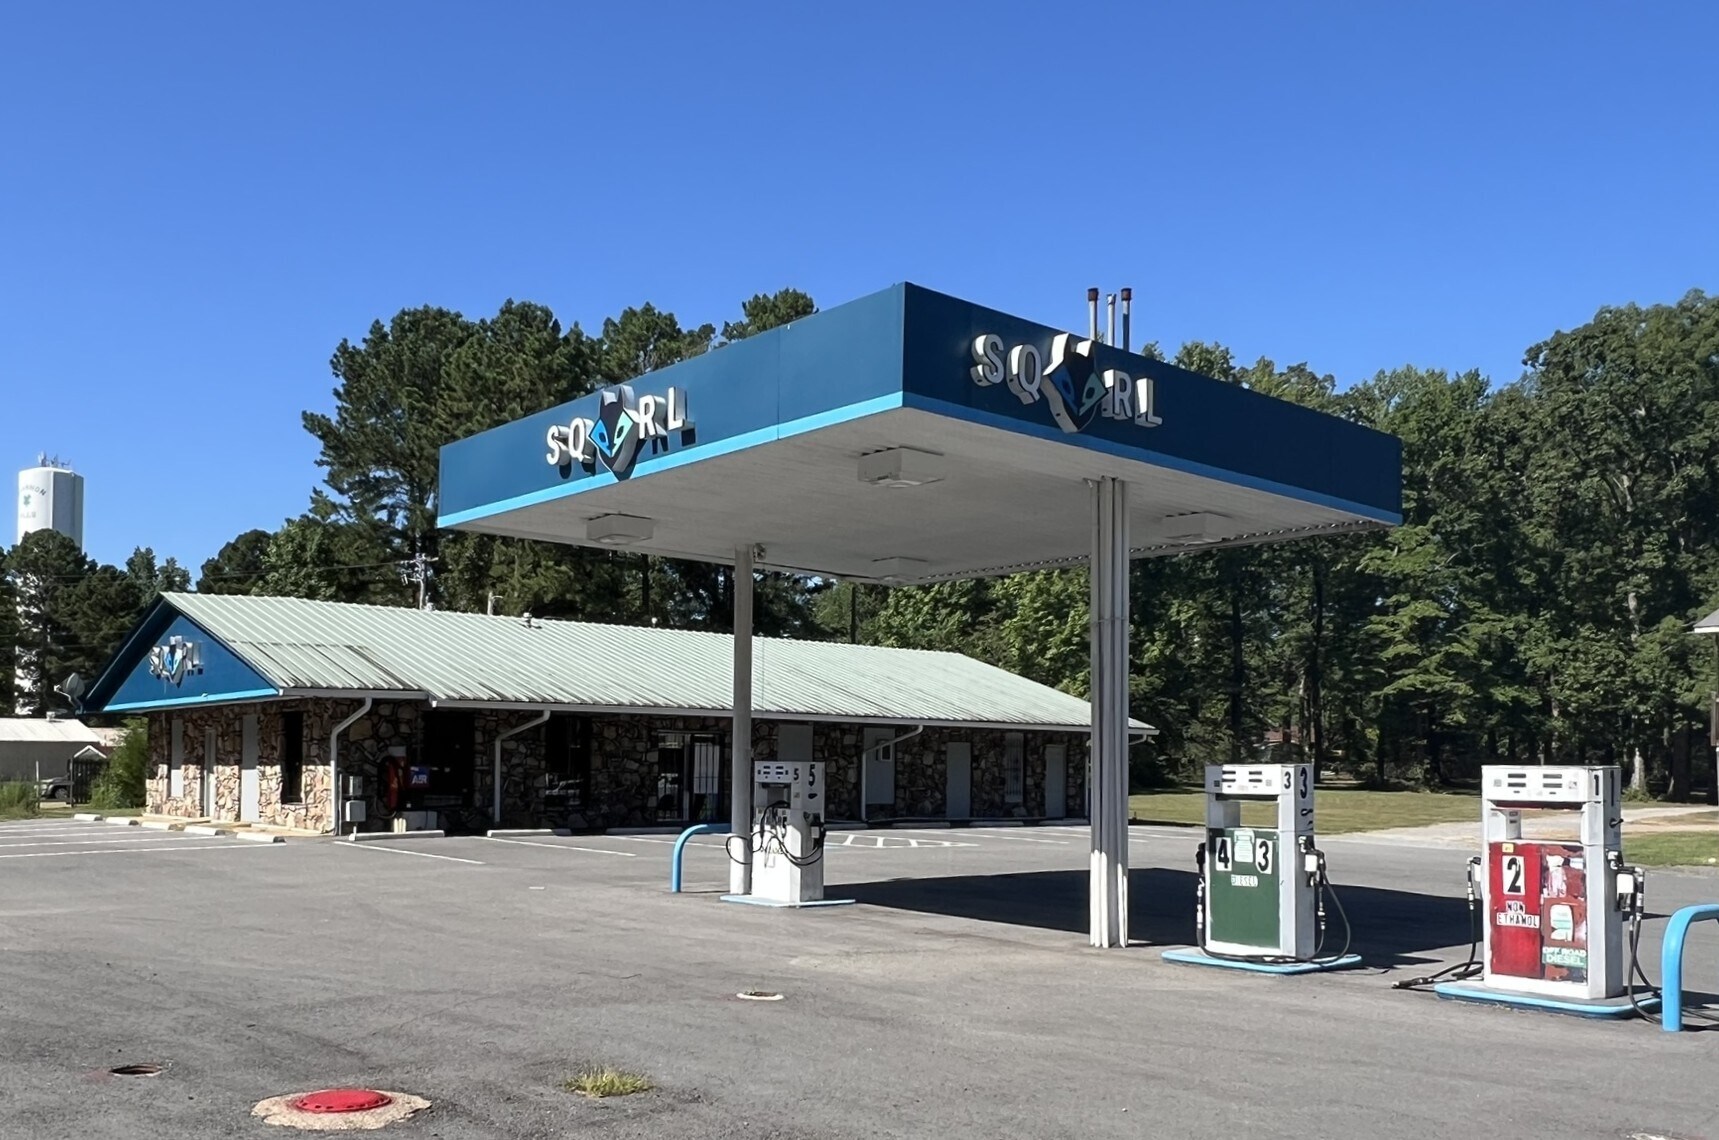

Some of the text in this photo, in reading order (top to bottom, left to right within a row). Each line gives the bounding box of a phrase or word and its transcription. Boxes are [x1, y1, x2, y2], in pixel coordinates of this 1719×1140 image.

[793, 767, 799, 781] 5
[807, 764, 816, 787] 5
[1284, 771, 1291, 789] 3
[1300, 767, 1308, 799] 3
[1594, 774, 1599, 796] 1
[1218, 838, 1230, 869] 4
[1258, 840, 1269, 872] 3
[1507, 857, 1521, 893] 2
[1506, 902, 1524, 912] NON
[1546, 954, 1585, 966] DIESEL
